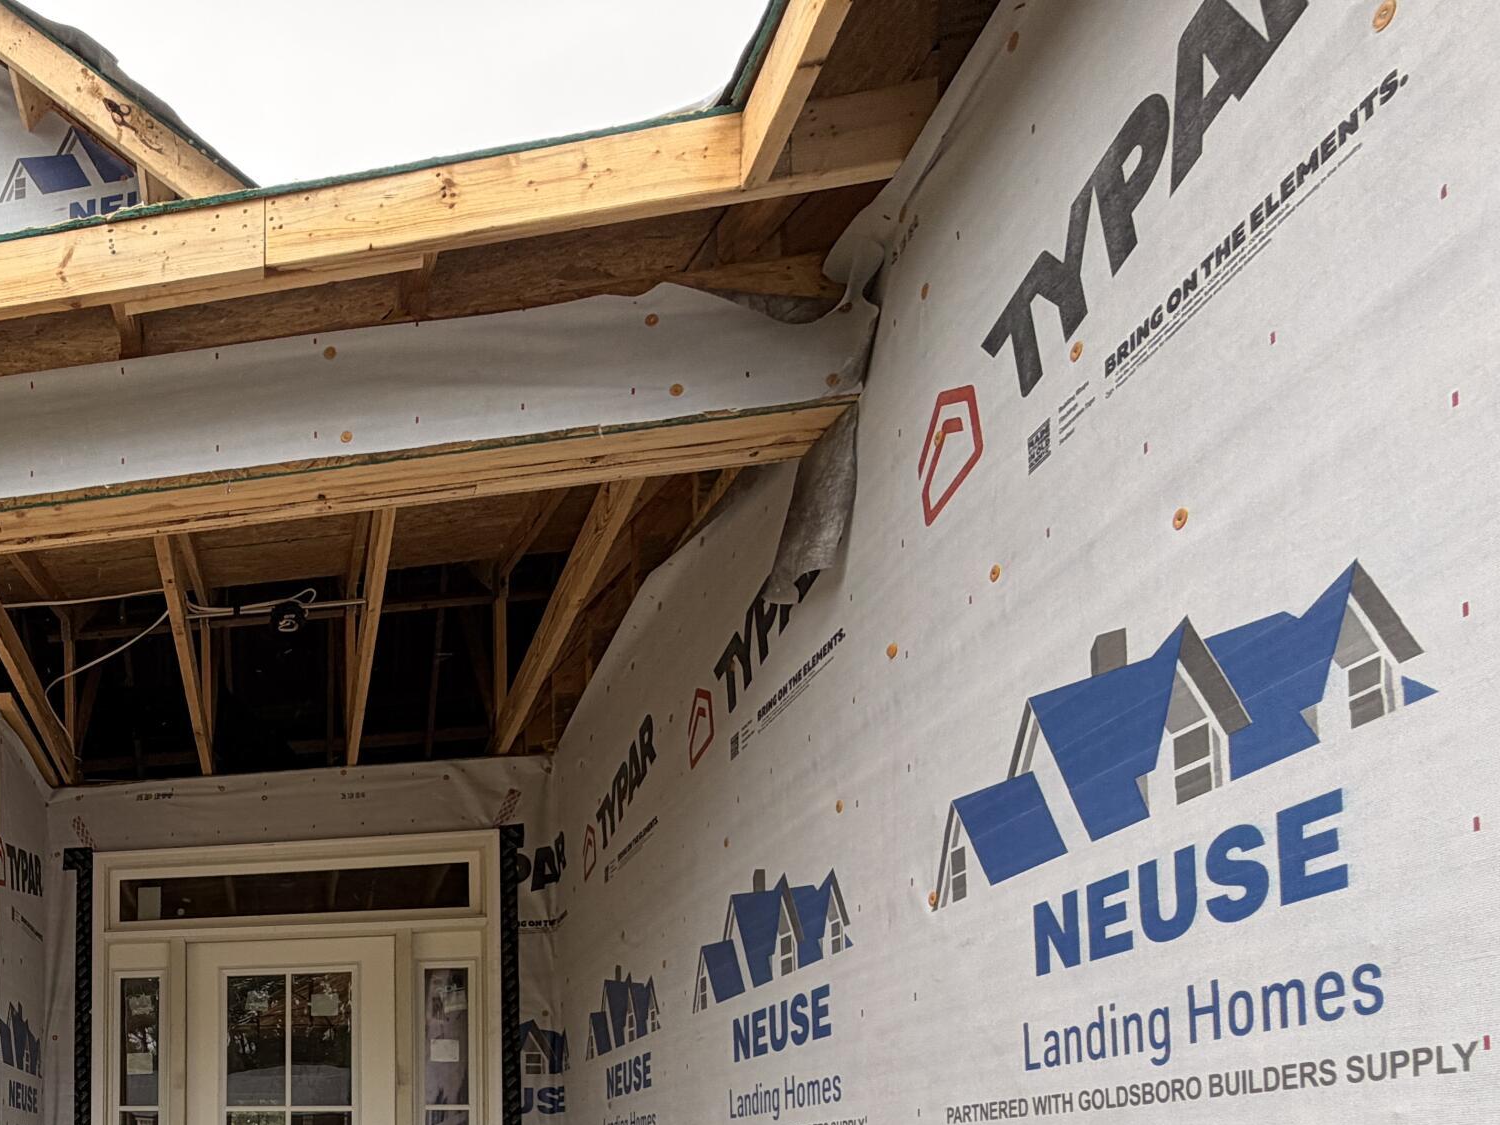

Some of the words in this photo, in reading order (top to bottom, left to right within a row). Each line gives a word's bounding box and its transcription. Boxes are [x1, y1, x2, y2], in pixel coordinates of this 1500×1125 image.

[981, 0, 1308, 398] TYPA
[1105, 304, 1163, 379] BRING
[1167, 268, 1197, 313] ON
[1199, 220, 1246, 278] THE
[1250, 69, 1409, 234] ELEMENTS.
[757, 694, 778, 722] BRING
[778, 683, 788, 701] ON
[788, 668, 803, 691] THE
[596, 713, 657, 850] TYPAR
[5, 843, 43, 897] TYPAR
[1033, 788, 1349, 977] NEUSE
[733, 984, 832, 1063] NEUSE
[1024, 1002, 1171, 1072] Landing
[1187, 962, 1385, 1044] Homes
[9, 1079, 38, 1114] NEUSE
[606, 1052, 652, 1100] NEUSE
[729, 1082, 780, 1121] Landing
[784, 1075, 841, 1110] Homes
[947, 1098, 1029, 1125] PARTNERED
[1032, 1092, 1074, 1117] WITH
[1078, 1076, 1202, 1112] GOLDSBORO
[1209, 1058, 1337, 1098] BUILDERS
